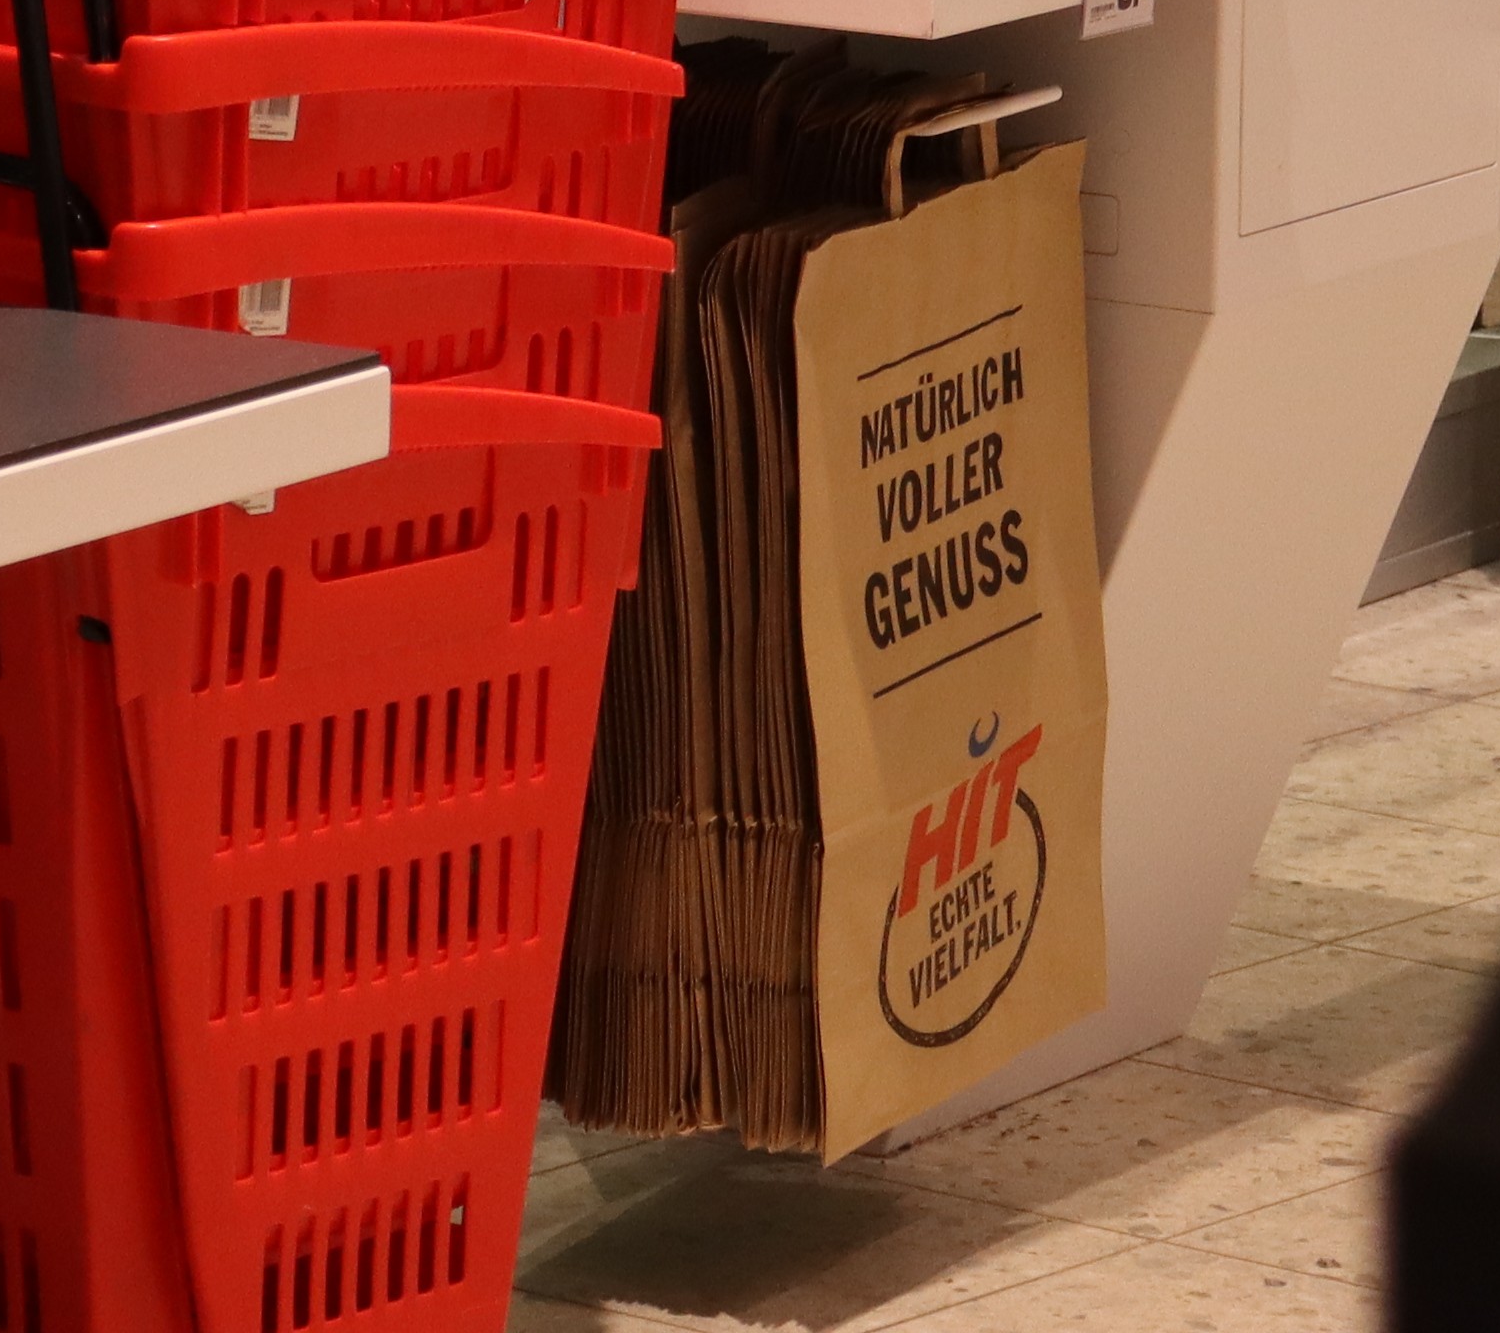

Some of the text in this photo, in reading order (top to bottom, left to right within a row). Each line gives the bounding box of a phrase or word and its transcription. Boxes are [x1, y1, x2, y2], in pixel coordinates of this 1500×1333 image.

[861, 347, 1024, 469] NATÜRLICH
[877, 432, 1003, 543] VOLLER
[864, 509, 1028, 650] GENUSS
[898, 710, 1043, 919] HIT
[909, 890, 1022, 1009] VIELFALT.
[929, 861, 996, 944] ECHTE
